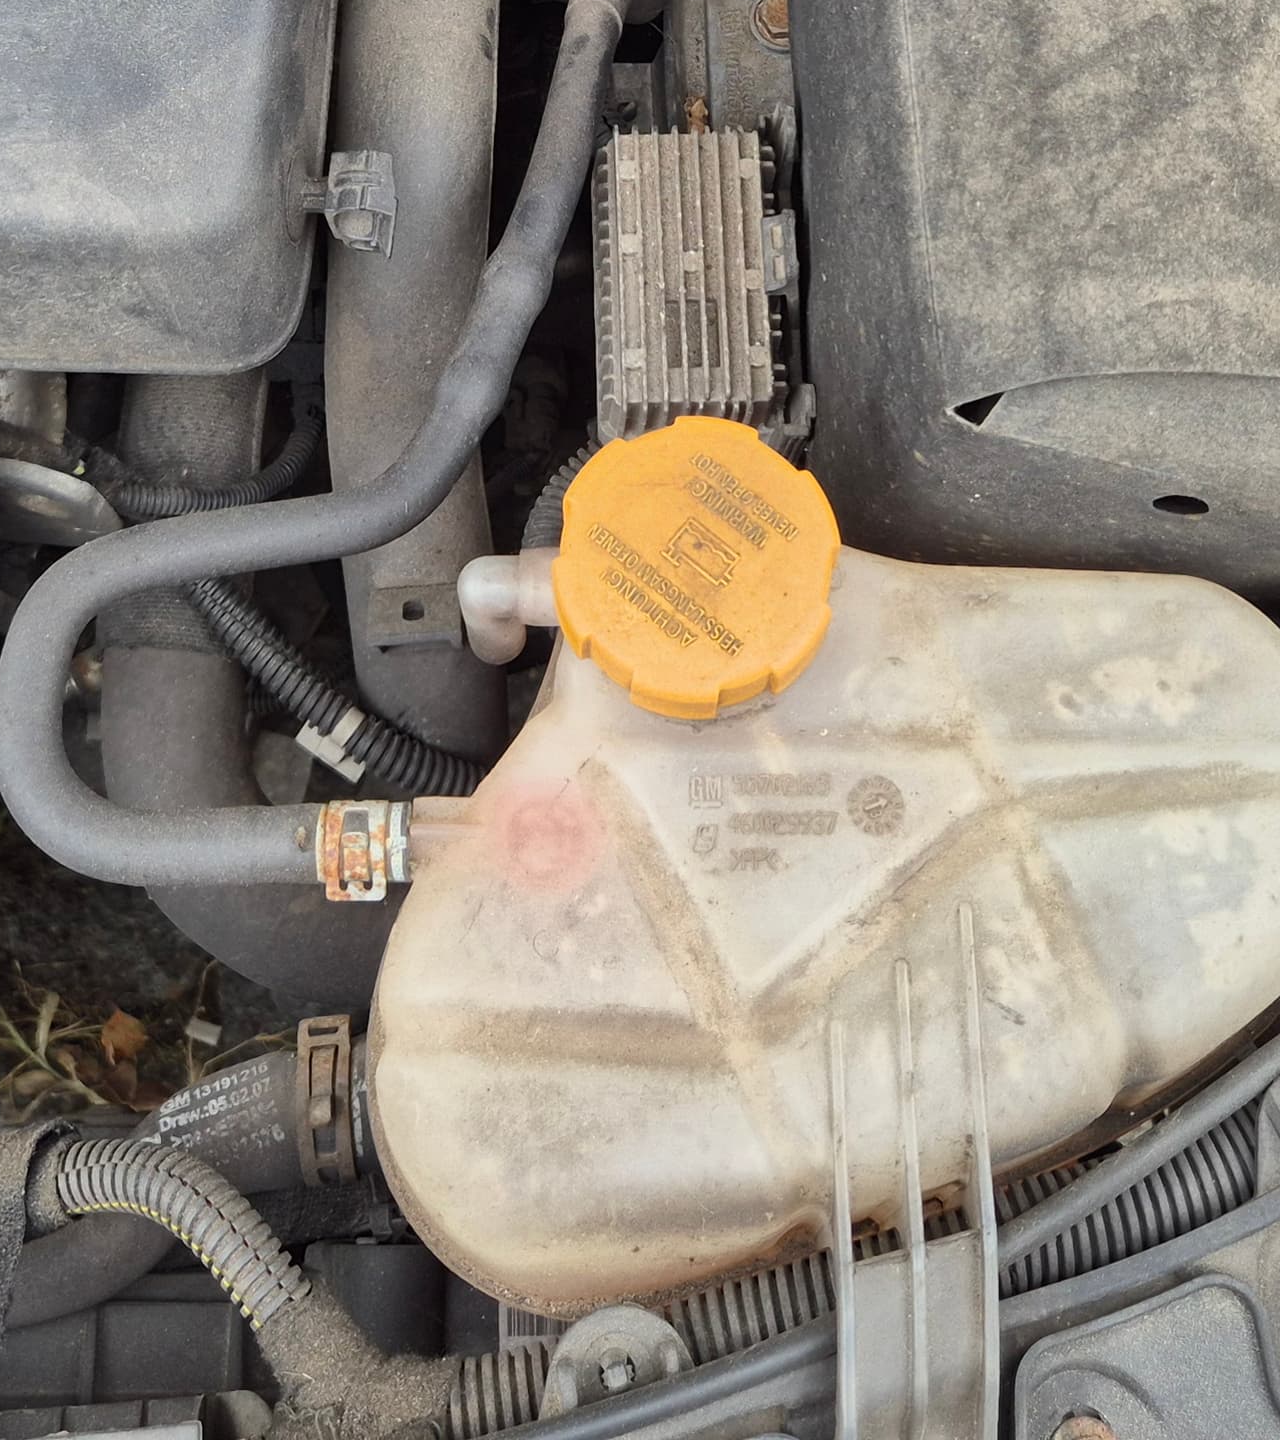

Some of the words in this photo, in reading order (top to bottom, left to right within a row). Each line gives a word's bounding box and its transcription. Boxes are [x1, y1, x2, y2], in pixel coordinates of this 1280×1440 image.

[689, 451, 724, 481] HOT
[716, 470, 754, 505] OPEN
[752, 499, 799, 541] NEVER
[636, 563, 707, 625] LANGSAM
[701, 616, 745, 657] HEISS
[688, 774, 724, 809] GM
[159, 1090, 191, 1117] GM
[192, 1061, 269, 1101] 13191216
